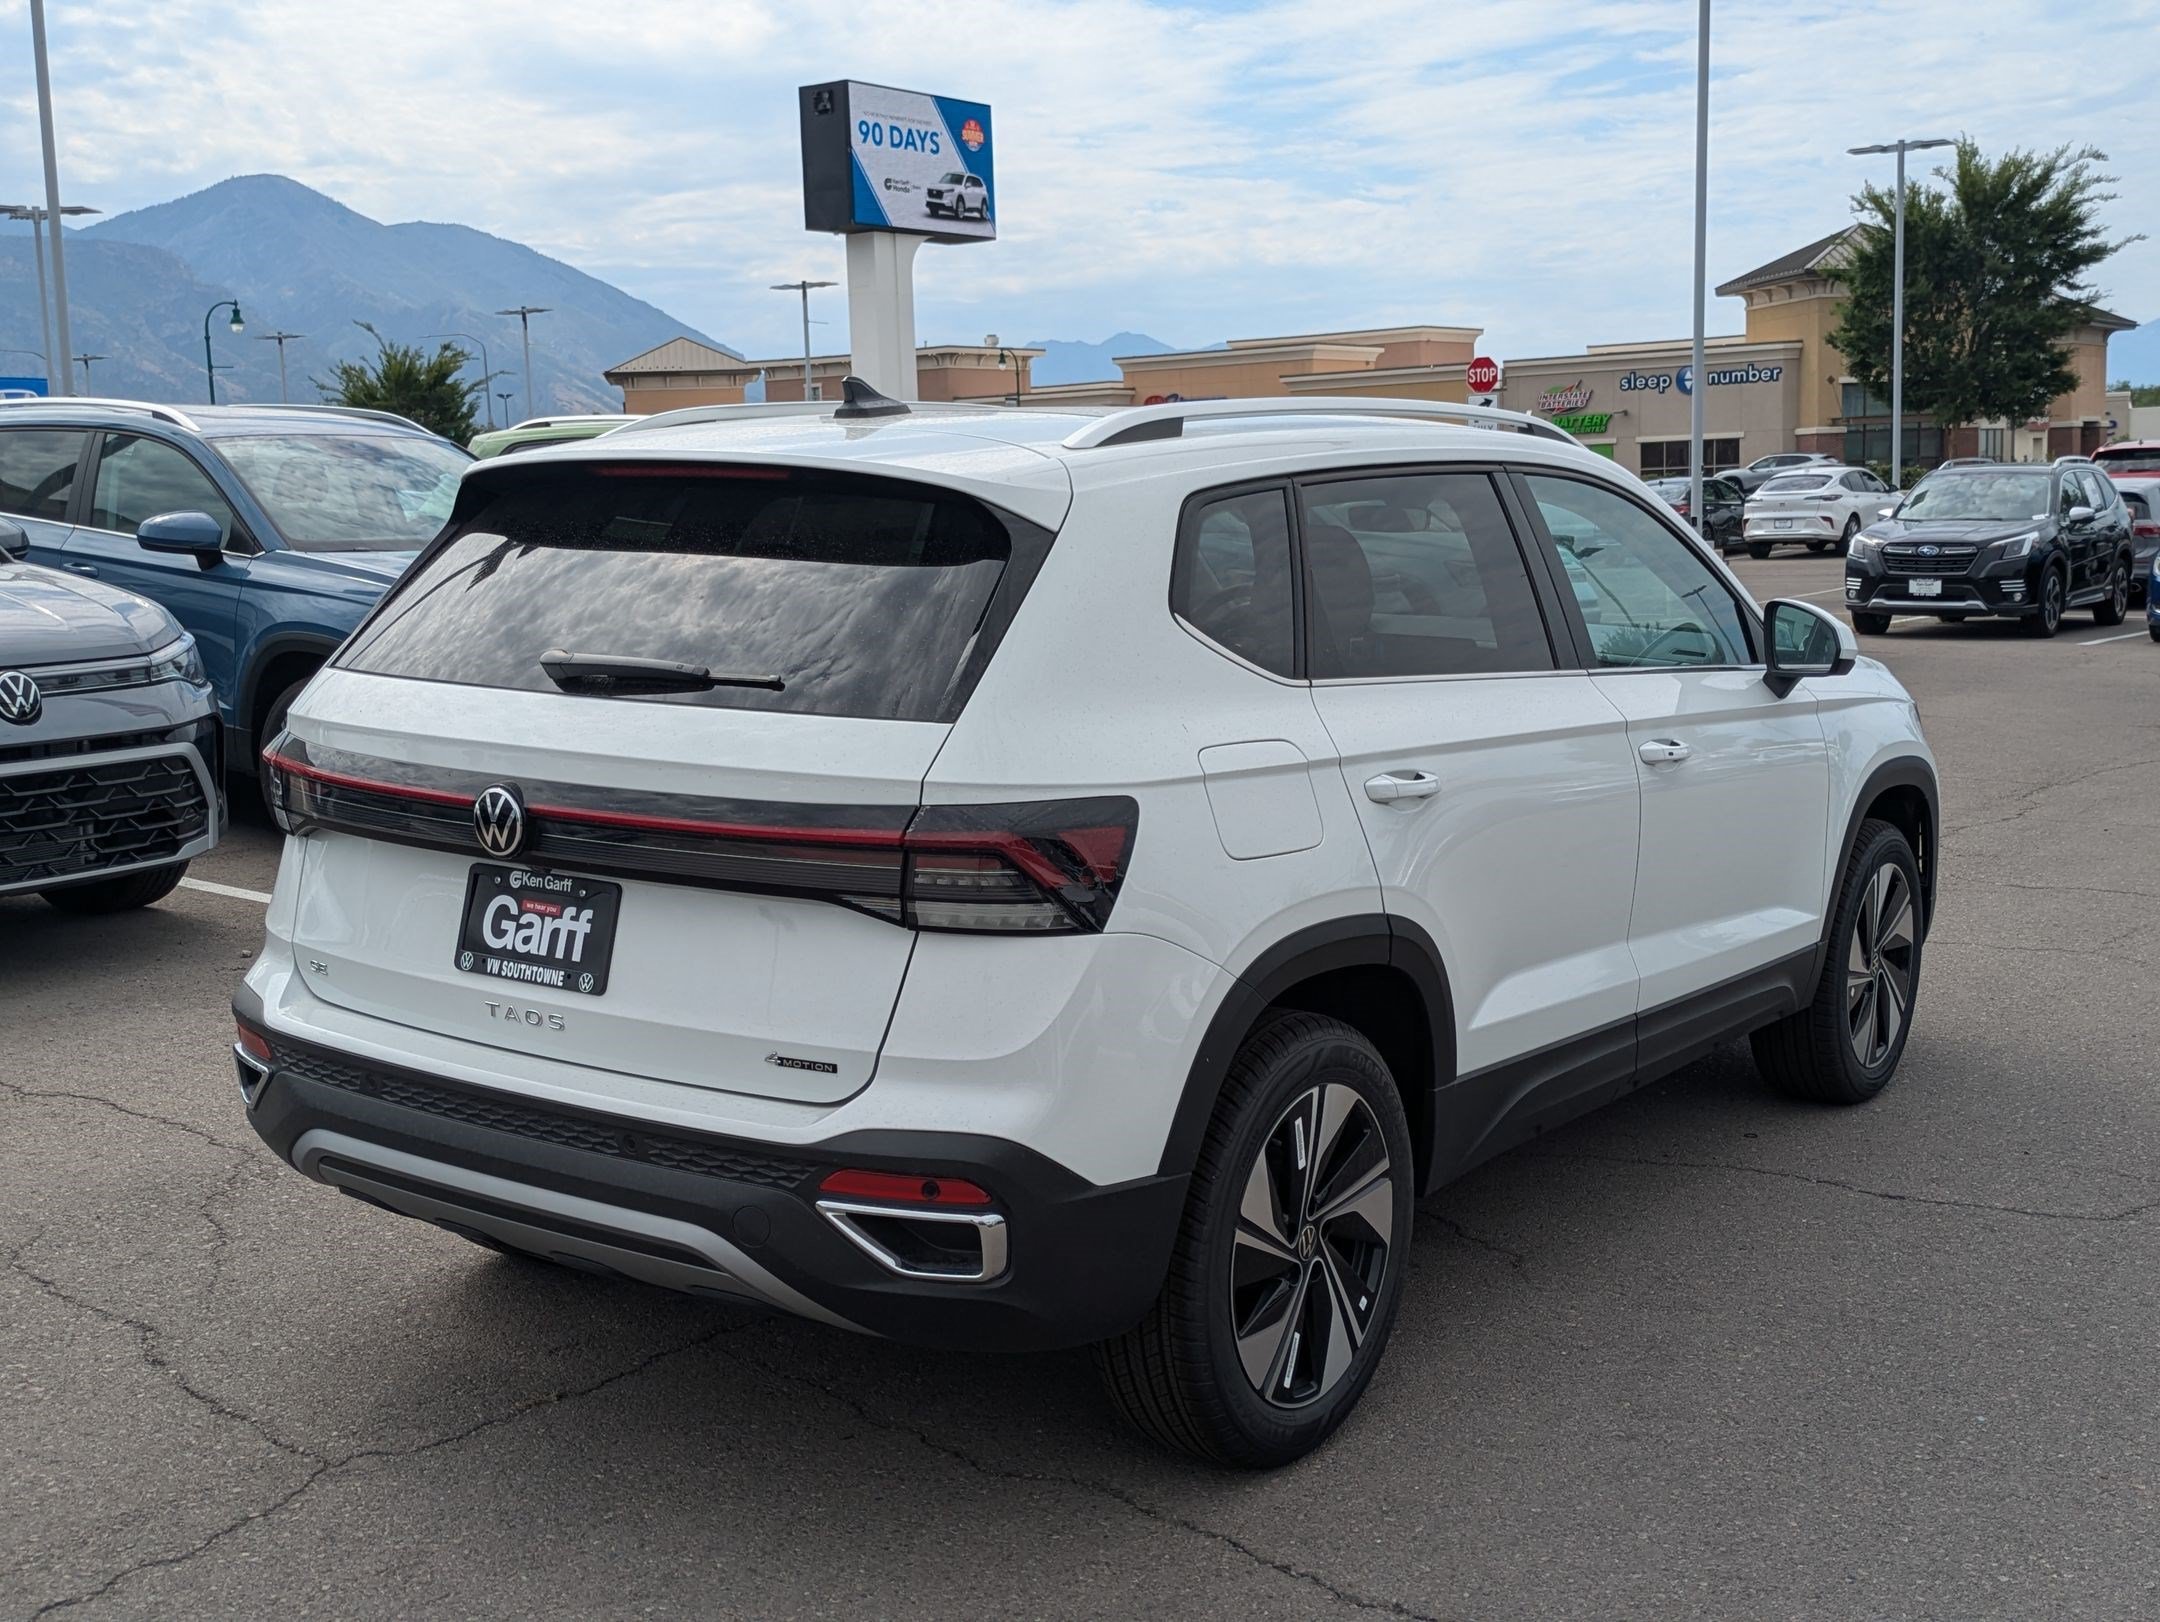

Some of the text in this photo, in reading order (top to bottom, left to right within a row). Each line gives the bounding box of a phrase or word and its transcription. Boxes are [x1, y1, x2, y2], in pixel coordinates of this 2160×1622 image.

[858, 120, 940, 155] 90 DAYS
[1468, 367, 1497, 383] STOP
[1620, 364, 1781, 393] sleep number
[1538, 391, 1591, 402] INTERSTATE
[1540, 399, 1587, 410] BATTERIES
[1553, 414, 1610, 427] BATTERY
[1575, 425, 1606, 433] CENTER
[522, 871, 543, 888] Ken
[544, 875, 573, 892] Garff
[535, 902, 547, 910] hear
[482, 894, 593, 963] Garff
[310, 959, 328, 976] SE
[486, 957, 565, 987] VW SOUTHTOWNE
[484, 1000, 566, 1031] TAOS
